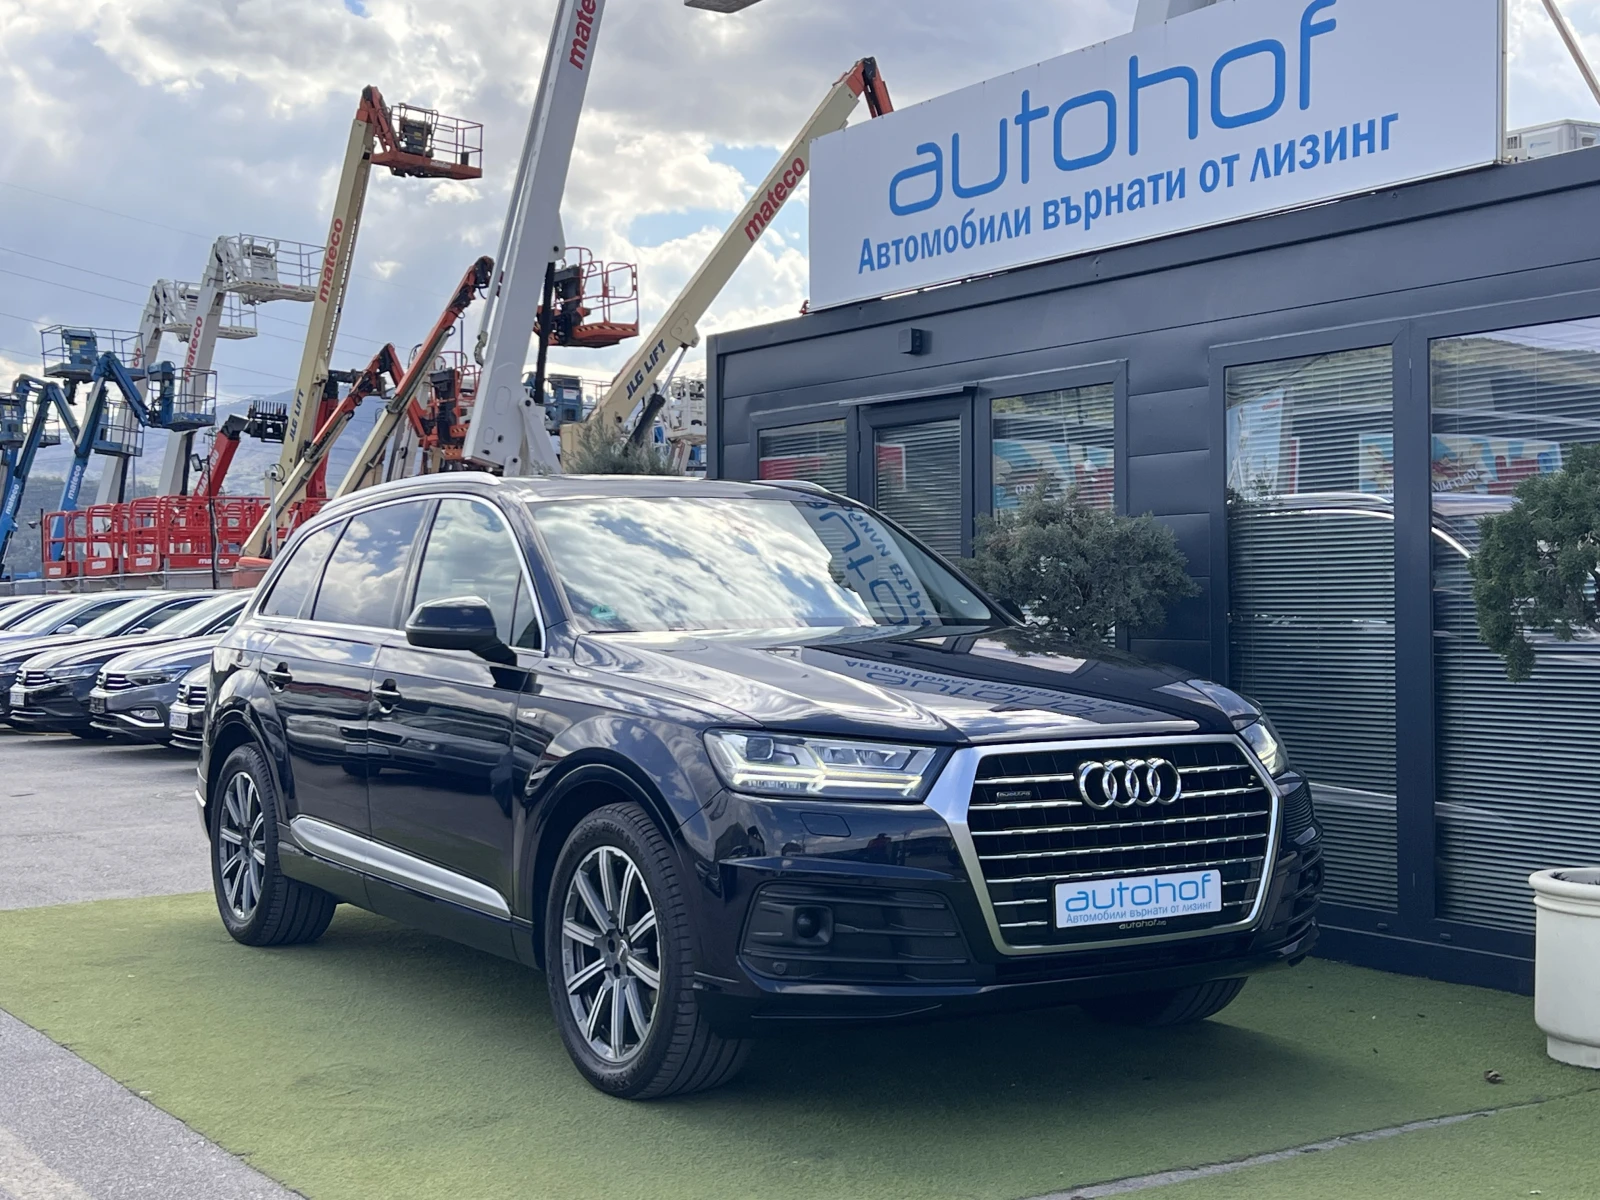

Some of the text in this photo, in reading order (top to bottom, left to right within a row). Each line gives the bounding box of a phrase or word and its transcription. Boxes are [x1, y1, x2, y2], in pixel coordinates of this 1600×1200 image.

[889, 0, 1336, 216] autohof
[744, 157, 805, 242] mateco
[858, 112, 1399, 274] Автомобили върнати от лизинг
[319, 218, 343, 303] mateco
[184, 315, 203, 383] mateco
[626, 338, 667, 400] JLG LIFT
[289, 420, 298, 442] JLG
[5, 484, 20, 515] mateco
[67, 465, 82, 500] mateco
[1065, 873, 1211, 912] autohof
[1066, 901, 1213, 923] Автомобили върнати от лизинг
